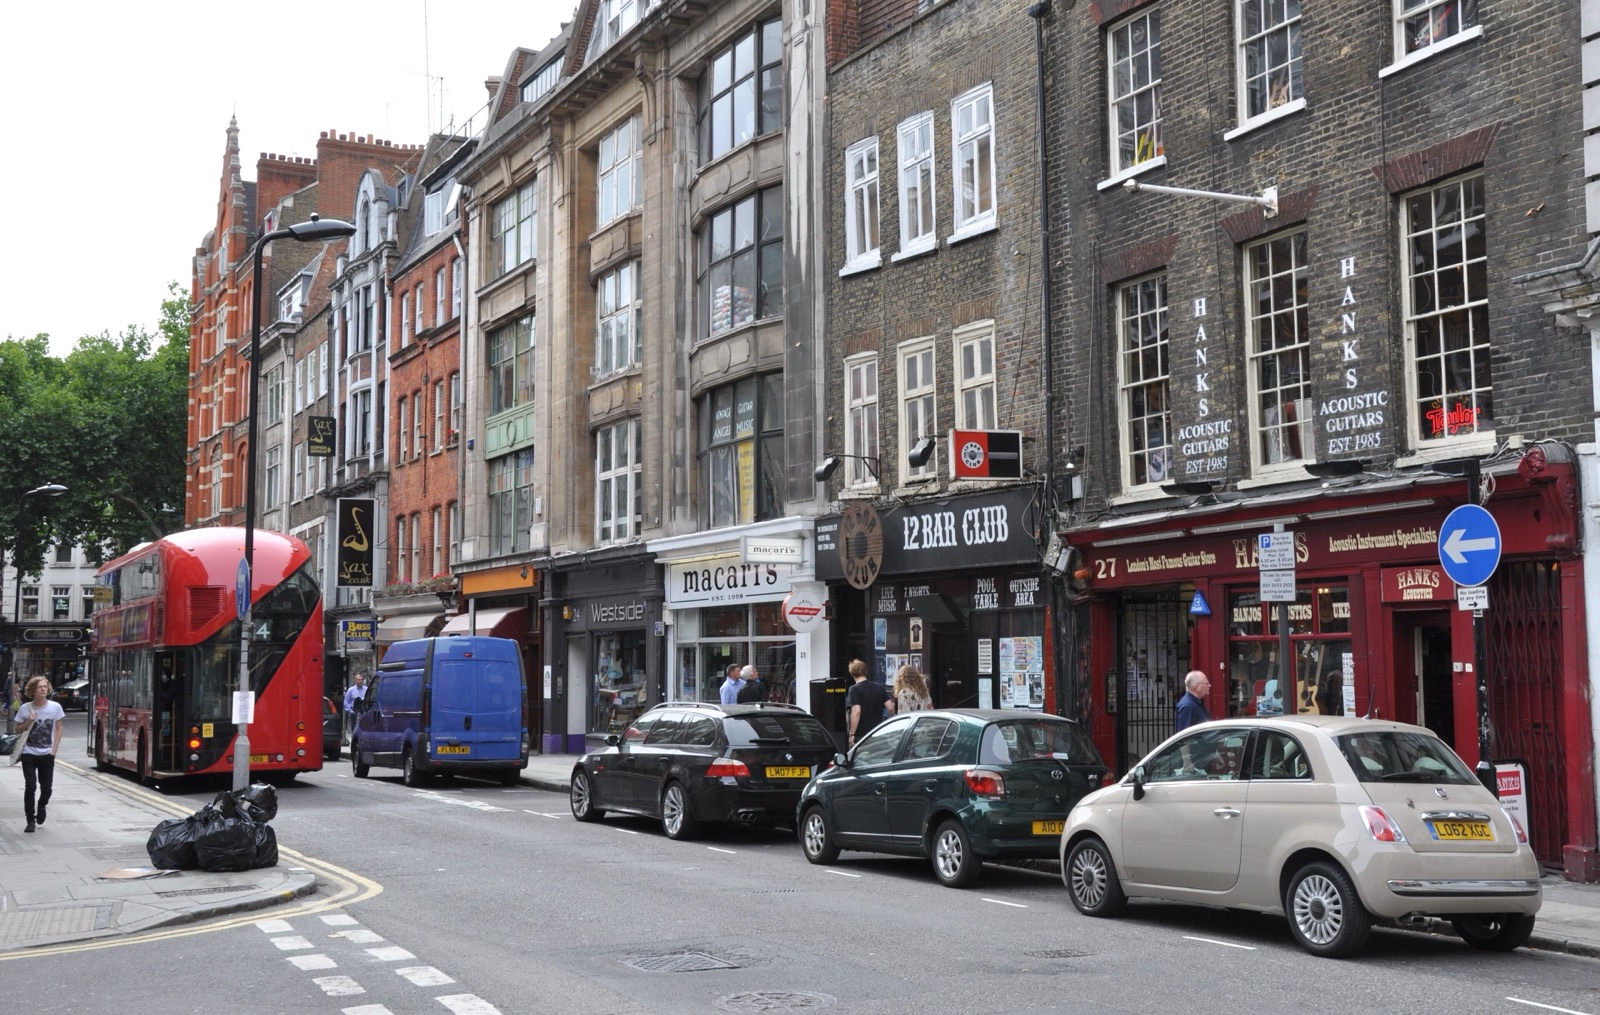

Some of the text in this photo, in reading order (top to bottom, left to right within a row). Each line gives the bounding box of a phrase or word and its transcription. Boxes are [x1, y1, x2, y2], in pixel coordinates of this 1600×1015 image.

[1340, 256, 1359, 389] HANKS
[1194, 297, 1210, 417] HANKS
[737, 401, 753, 414] GUITAR
[1320, 391, 1388, 416] ACOUSTIC
[713, 418, 754, 440] ANGEL MUSIC
[1326, 411, 1383, 432] GUITARS
[1426, 403, 1480, 434] Taylor
[1178, 419, 1232, 440] ACOUSTIC
[970, 443, 981, 451] BAR
[1183, 438, 1228, 455] GUITARS
[1328, 432, 1381, 453] EST 1985
[965, 459, 981, 467] CLUB
[1186, 456, 1228, 474] EST 1985
[856, 505, 876, 533] BAR
[903, 504, 1009, 550] 12 BAR CLUB
[1329, 526, 1437, 552] Acoustic Instrument Specialists
[753, 546, 796, 555] macari's
[846, 557, 878, 585] CLUB
[1095, 558, 1117, 579] 27
[1126, 550, 1217, 573] London's Most Famous Guitar Store
[683, 562, 778, 593] macaris
[976, 577, 1040, 594] POOL OUTSIDE
[1397, 568, 1440, 589] HANKS
[881, 586, 895, 600] LIVE
[908, 585, 930, 597] NIGHTS
[974, 592, 1035, 609] TABLE AREA
[1402, 588, 1433, 600] ACOUSTICS
[1467, 588, 1485, 596] loading
[573, 608, 580, 622] 24
[591, 600, 644, 622] Westside
[877, 599, 898, 612] MUSIC
[1233, 607, 1262, 622] BANJOS
[769, 767, 806, 776] LM07 FJF
[1435, 823, 1491, 837] LO62 XGC
